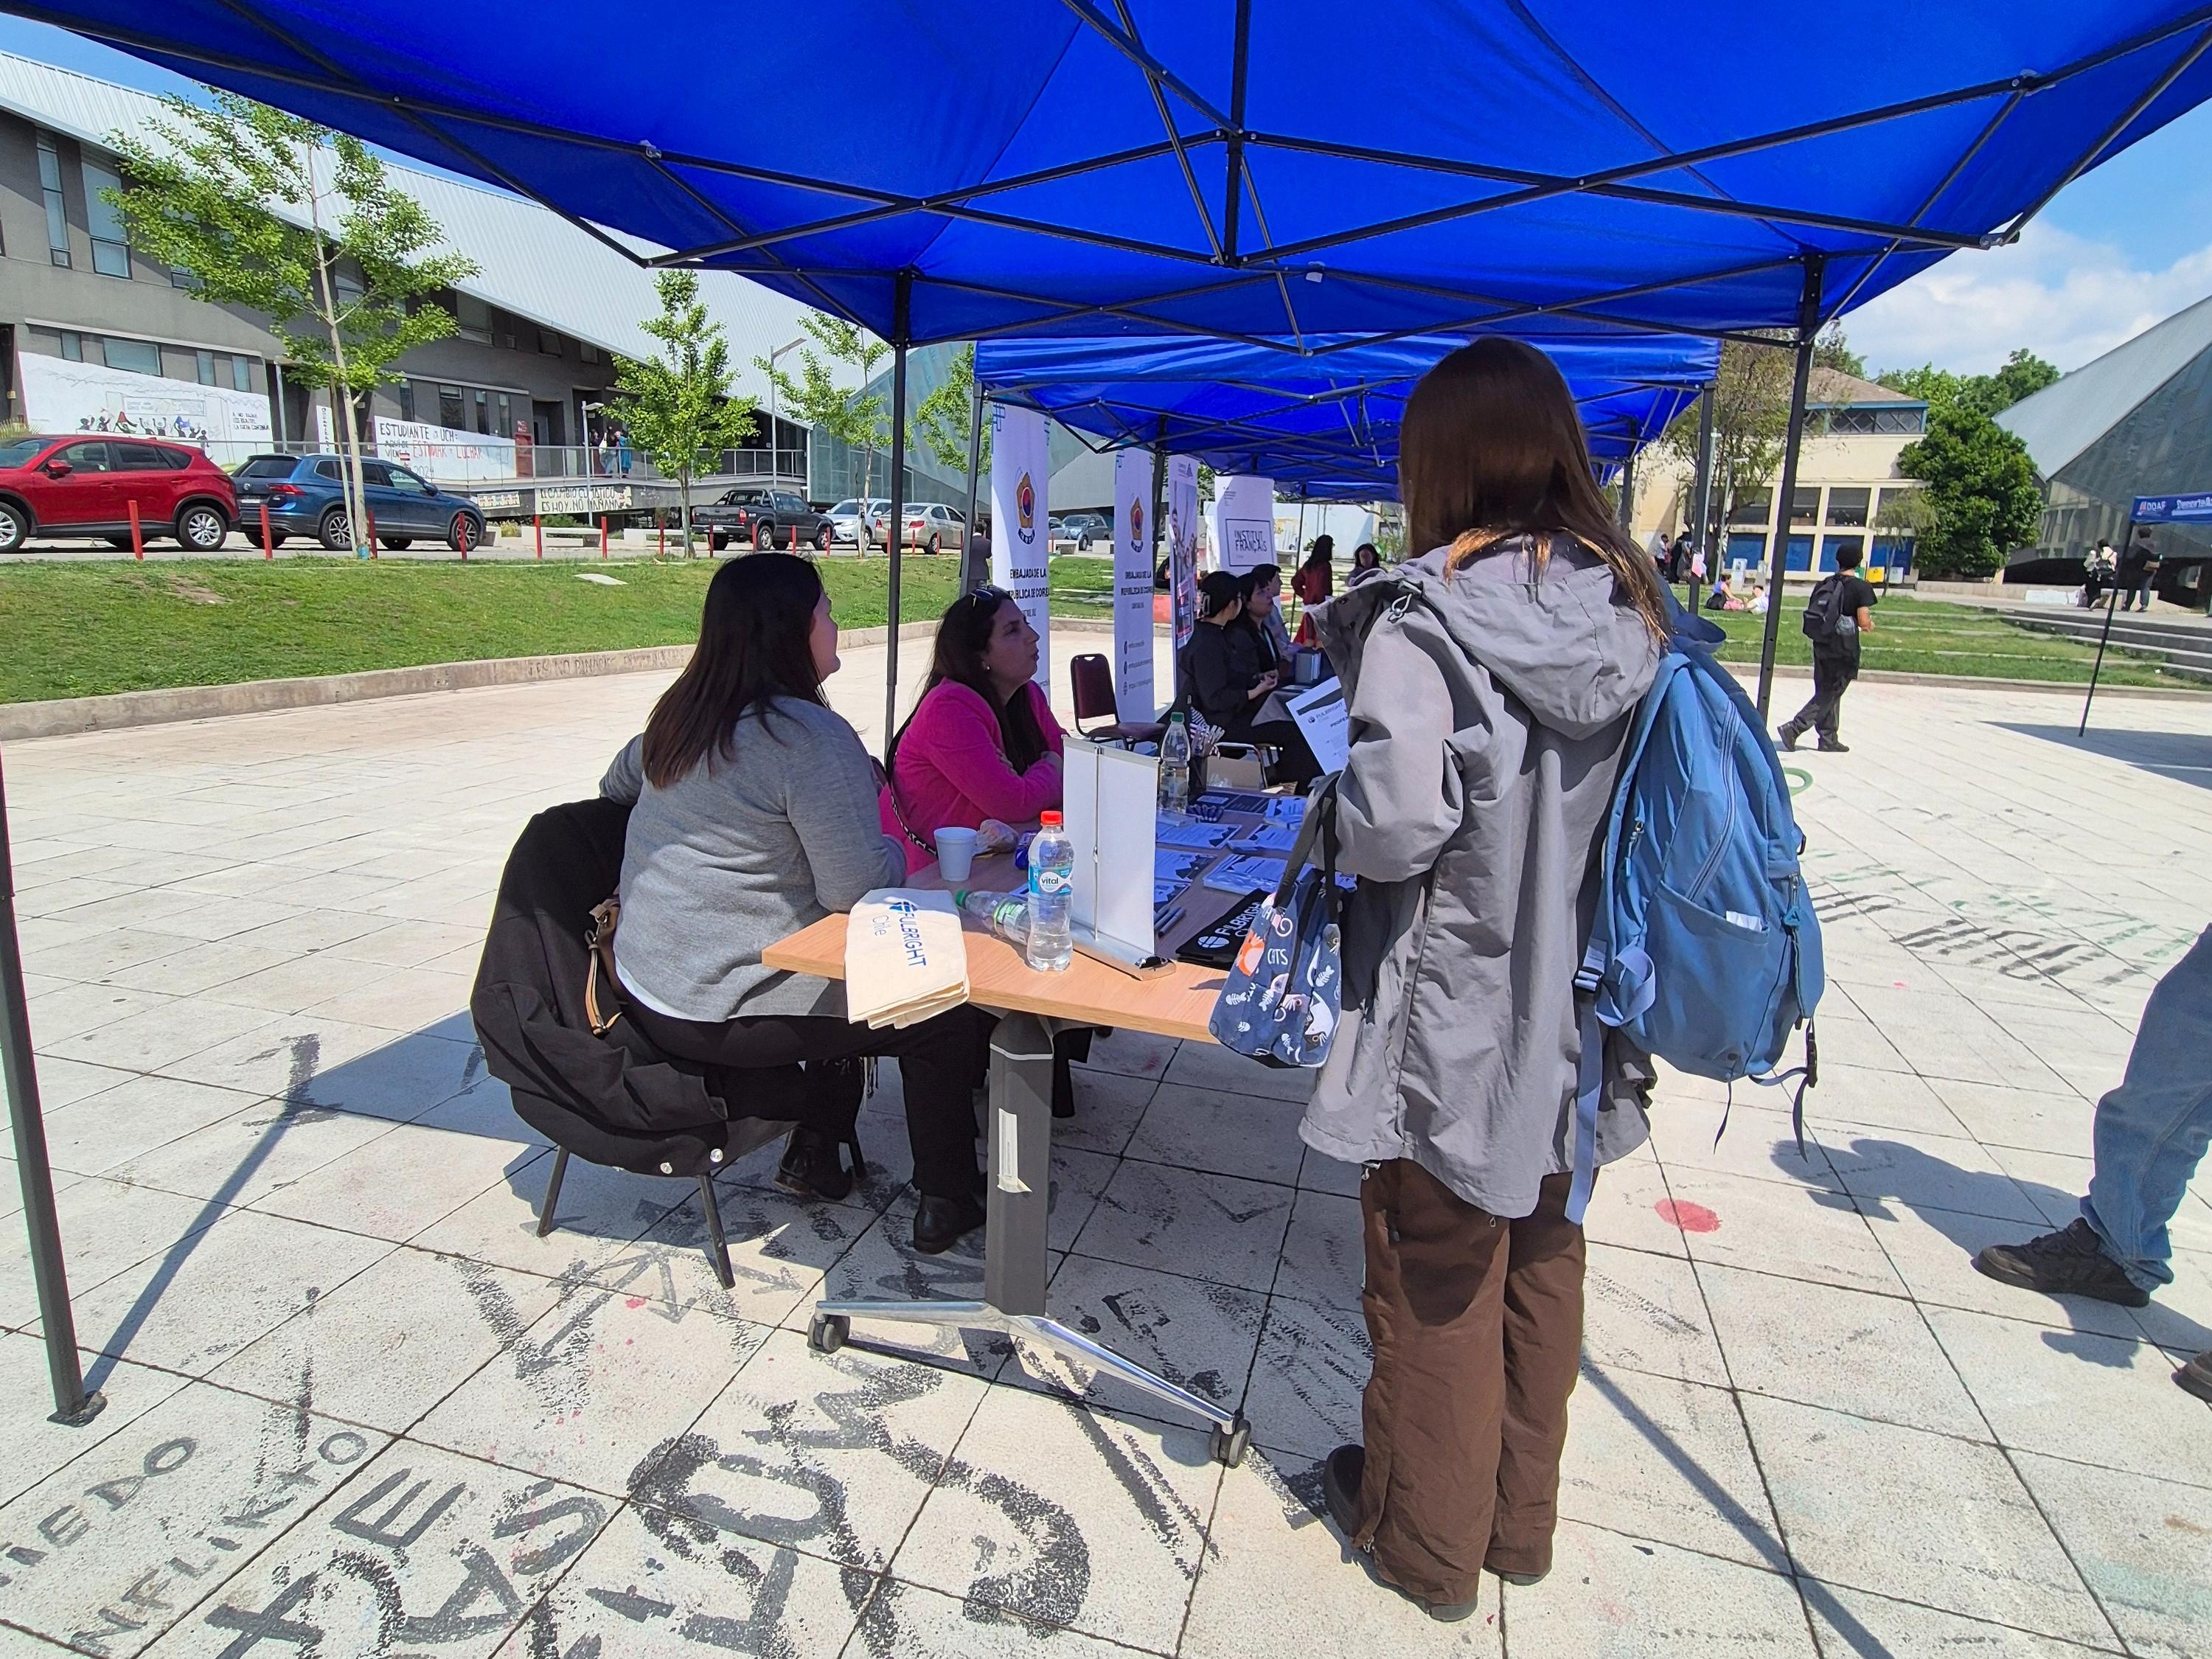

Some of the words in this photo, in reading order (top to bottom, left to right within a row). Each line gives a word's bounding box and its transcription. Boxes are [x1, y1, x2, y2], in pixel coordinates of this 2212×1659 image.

[380, 422, 430, 439] ESTUDIANTE
[414, 465, 435, 479] 2024
[547, 487, 576, 499] CAMBIO
[541, 501, 550, 512] ES
[572, 498, 584, 512] NO
[1234, 529, 1263, 542] INSTITUT
[1235, 540, 1267, 553] FRANÇAIS
[1009, 568, 1033, 579] EMBAJADA
[1040, 567, 1047, 577] LA
[1041, 877, 1059, 885] vital
[898, 912, 927, 967] FULBRIGHT
[1267, 947, 1289, 966] CATS
